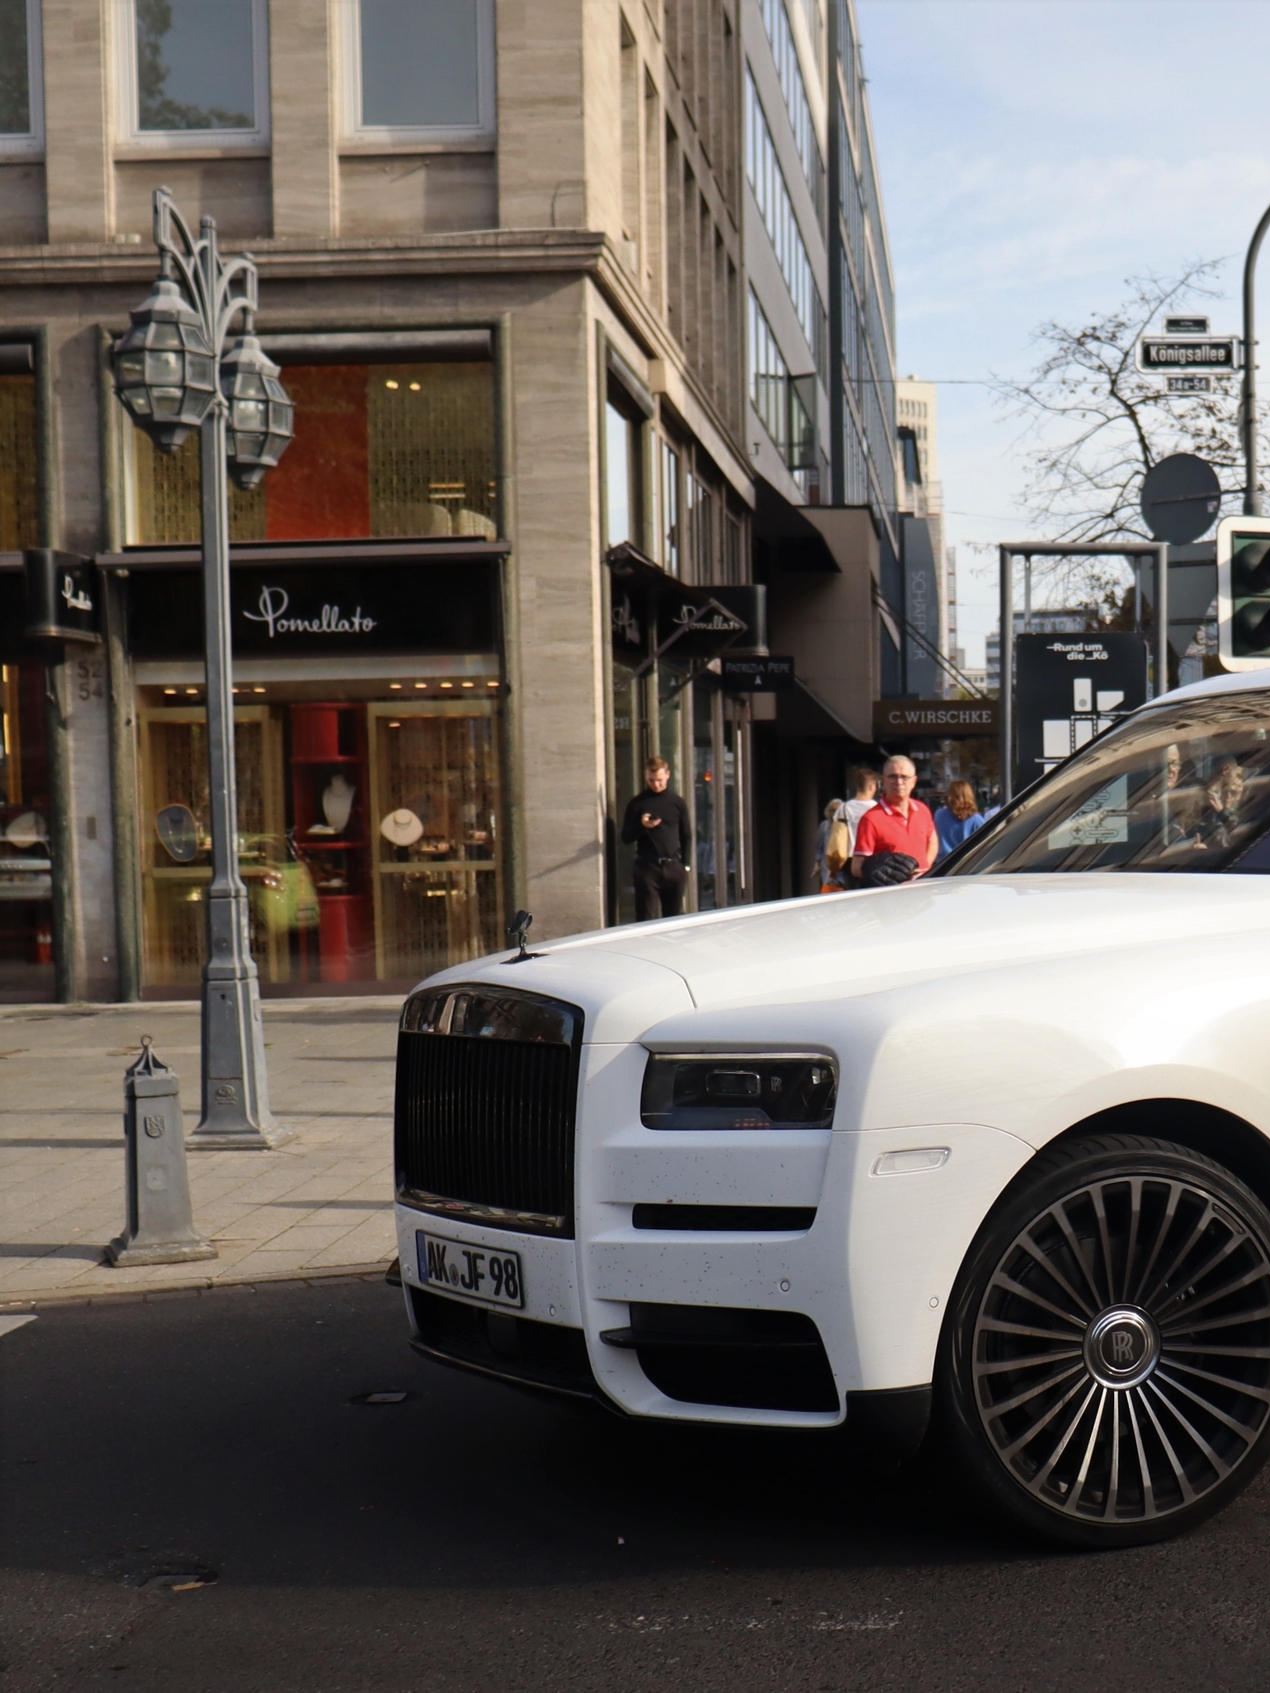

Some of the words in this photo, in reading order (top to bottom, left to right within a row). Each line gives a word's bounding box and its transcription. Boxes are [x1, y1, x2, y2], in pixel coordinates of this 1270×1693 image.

[1149, 345, 1226, 364] Königsallee
[1170, 379, 1207, 390] 34a-54
[243, 585, 377, 638] Pomellato
[1053, 643, 1083, 651] Rund
[1067, 651, 1085, 660] die
[725, 662, 765, 673] PATRIZIA
[767, 662, 790, 673] PEPE
[428, 1241, 450, 1284] AK
[461, 1250, 485, 1292] JF
[489, 1256, 519, 1299] 98
